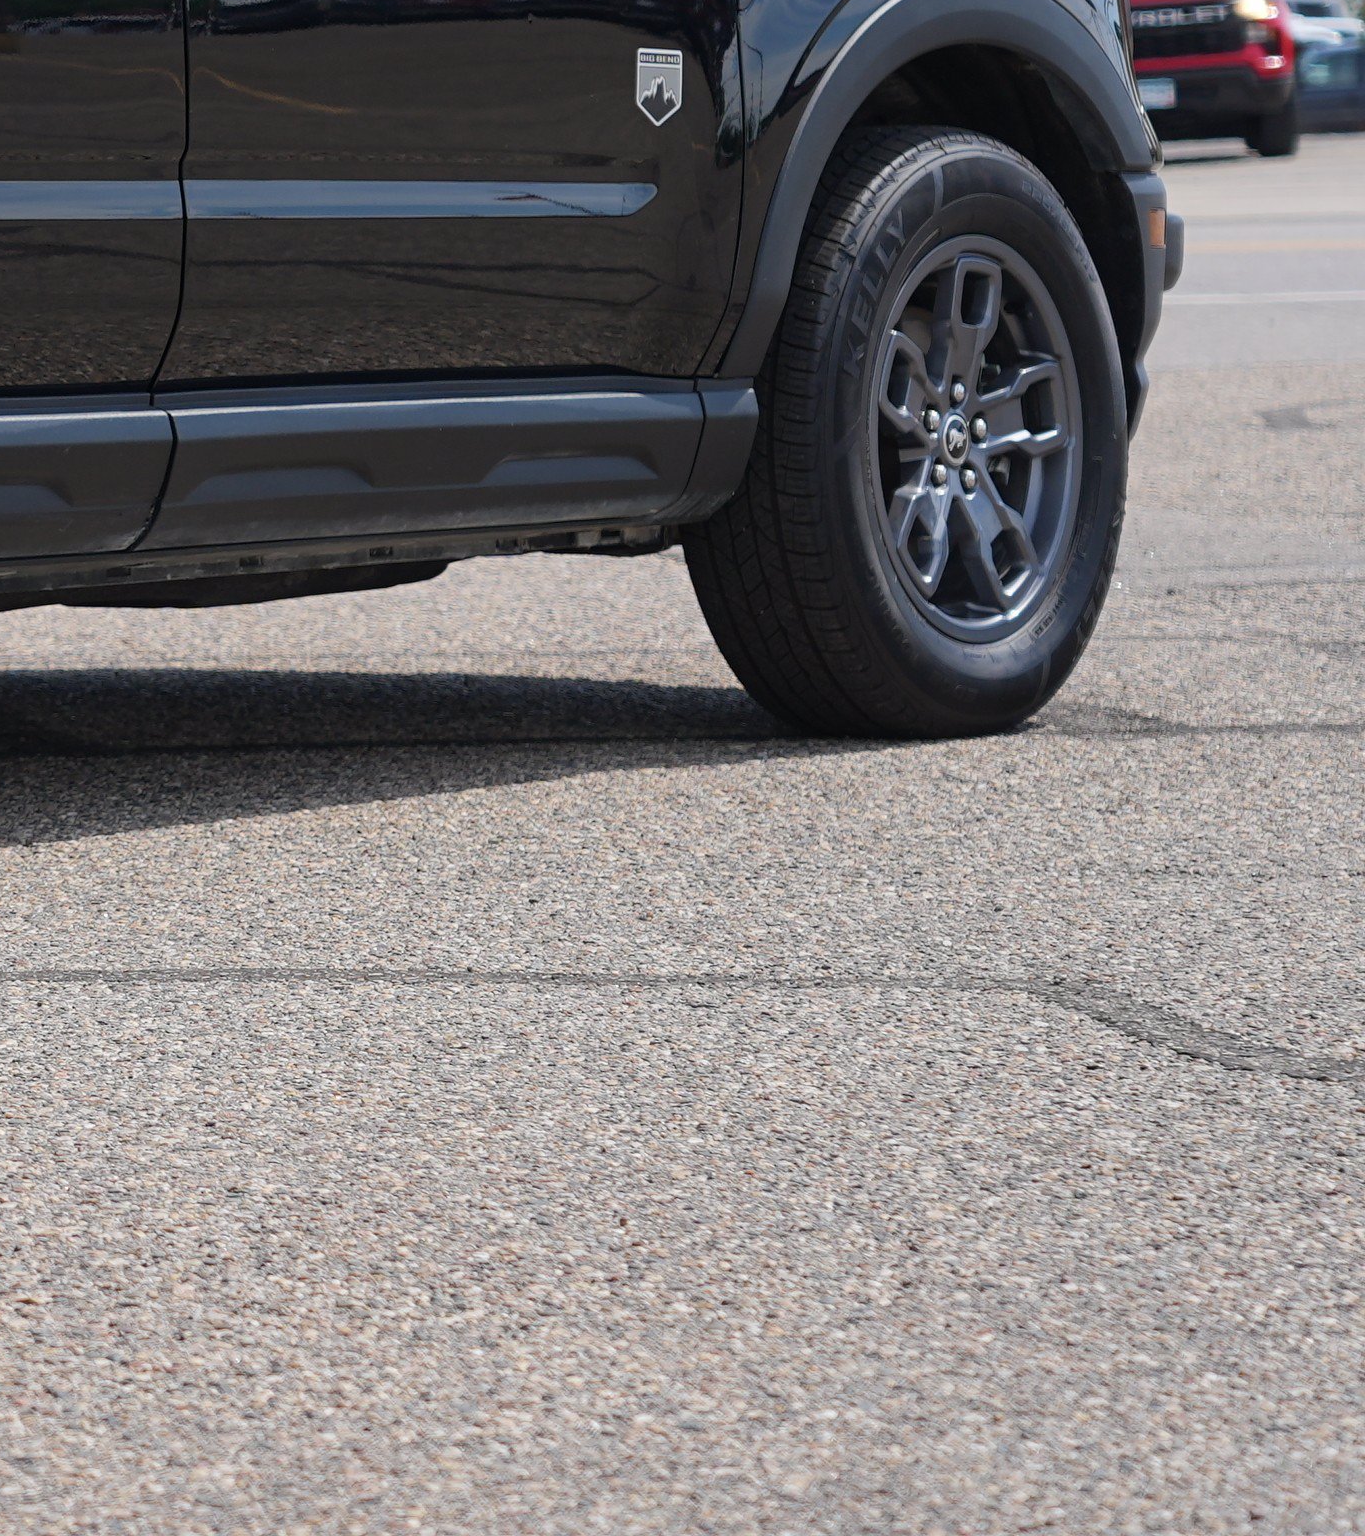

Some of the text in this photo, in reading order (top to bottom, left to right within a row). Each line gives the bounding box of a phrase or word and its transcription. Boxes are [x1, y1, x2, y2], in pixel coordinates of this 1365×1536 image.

[640, 54, 680, 64] BIG BEND
[843, 208, 906, 380] KELLY
